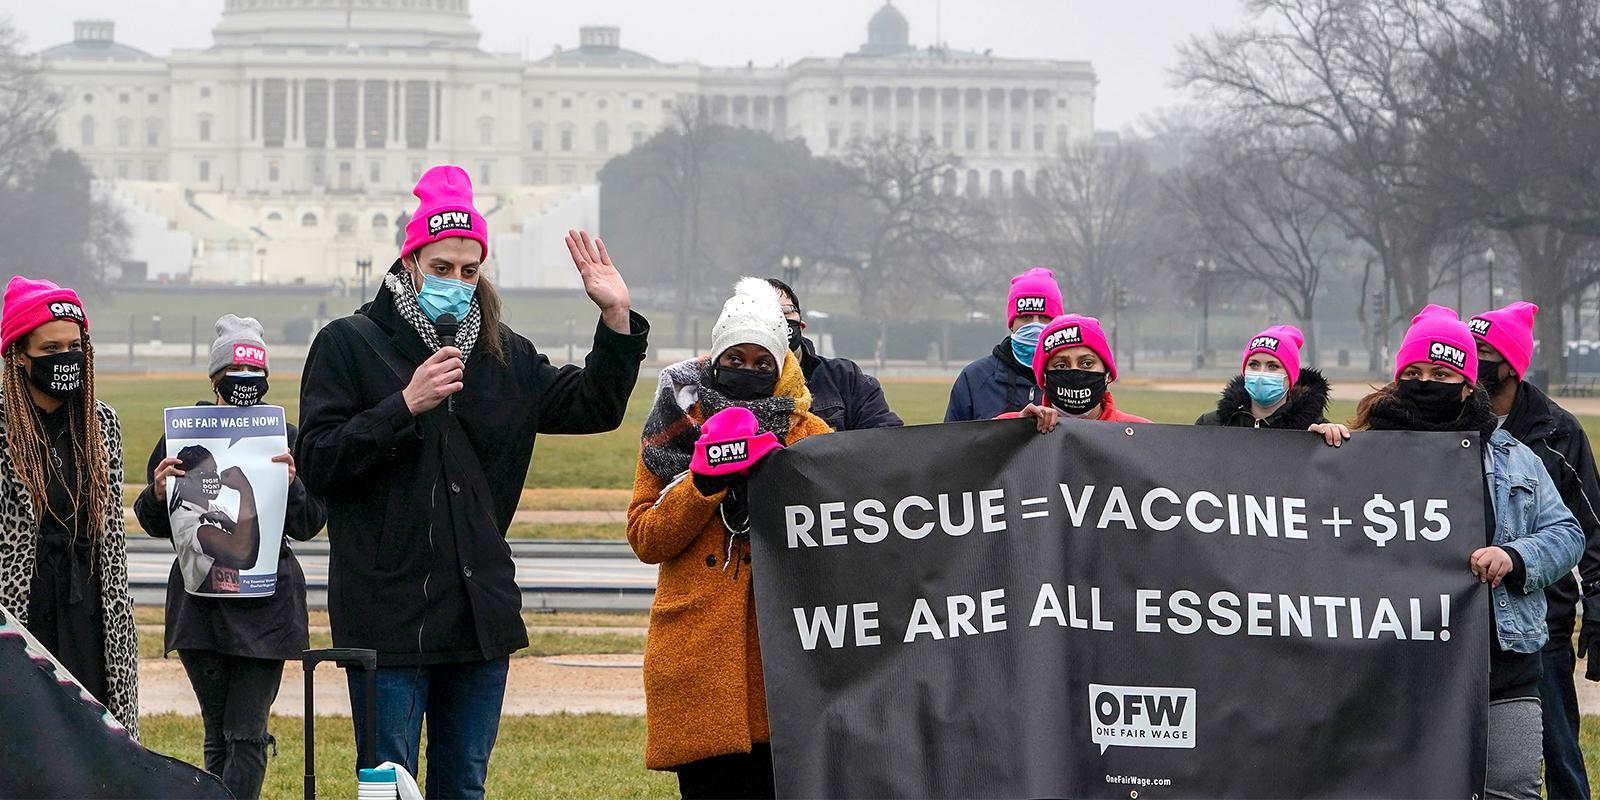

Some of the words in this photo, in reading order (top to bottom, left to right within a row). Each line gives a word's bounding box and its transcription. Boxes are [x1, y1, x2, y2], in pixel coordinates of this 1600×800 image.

[430, 212, 469, 228] OFW
[50, 302, 83, 316] OFW
[1018, 298, 1044, 308] OFW
[1044, 326, 1078, 346] OFW
[1252, 337, 1278, 348] OFW
[234, 346, 265, 361] OFW
[1432, 342, 1465, 363] OFW
[1057, 386, 1092, 398] UNITED
[172, 418, 194, 428] ONE
[196, 418, 218, 428] FAIR
[220, 418, 247, 428] WAGE
[252, 416, 279, 426] NOW!
[708, 442, 746, 458] OFW
[785, 489, 1007, 548] RESCUE
[1021, 497, 1049, 519] =
[1058, 484, 1309, 540] VACCINE
[1322, 507, 1352, 538] +
[1363, 494, 1451, 547] $15
[793, 602, 881, 650] WE
[904, 588, 1007, 643] ARE
[1029, 583, 1114, 631] ALL
[1136, 589, 1451, 642] ESSENTIAL!
[1095, 691, 1188, 726] OFW
[1096, 727, 1116, 737] ONE
[1120, 729, 1146, 738] FAIR
[1152, 730, 1188, 740] WAGE
[1106, 774, 1172, 787] OneFairWage.com
